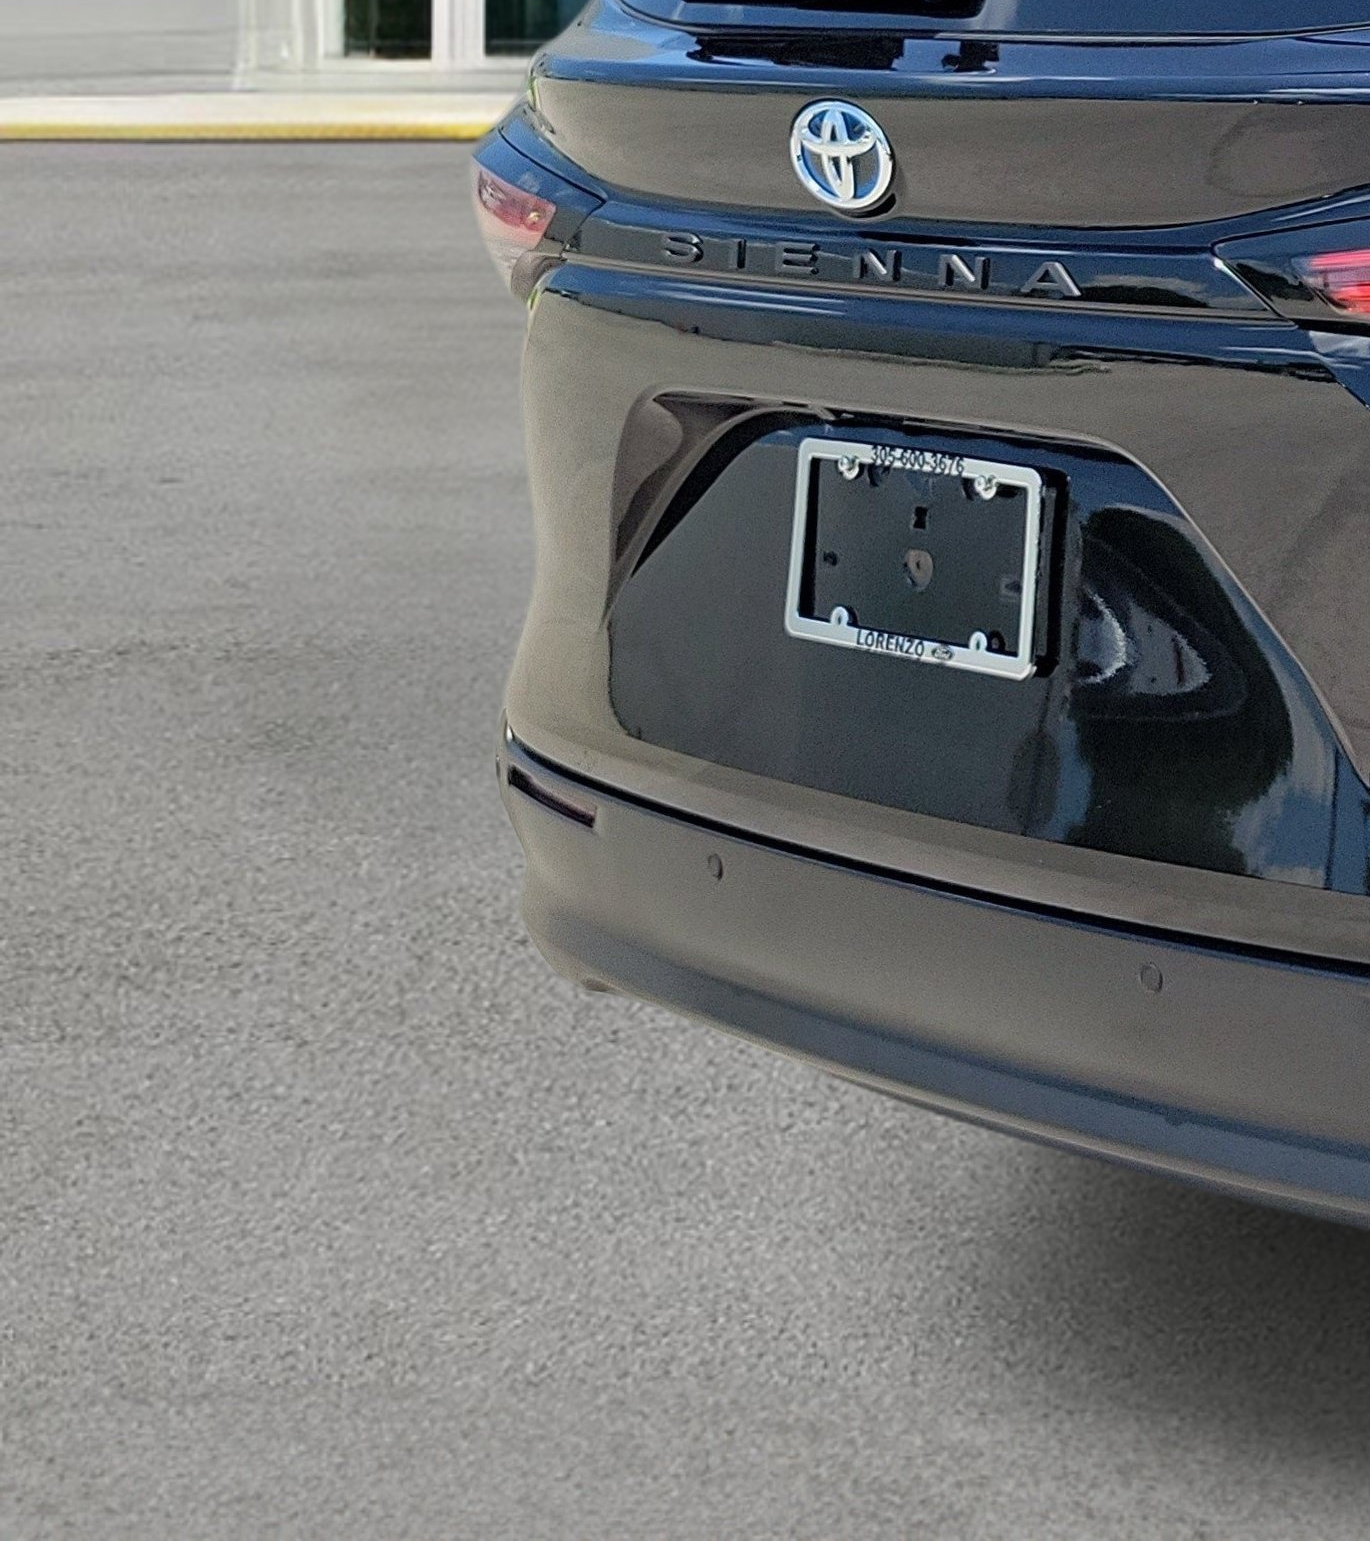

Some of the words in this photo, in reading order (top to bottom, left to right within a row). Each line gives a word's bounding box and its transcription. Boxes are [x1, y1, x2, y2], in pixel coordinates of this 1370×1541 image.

[660, 231, 1083, 298] SIENNA
[871, 445, 965, 474] 305-600-3676
[856, 629, 925, 657] LORENZO
